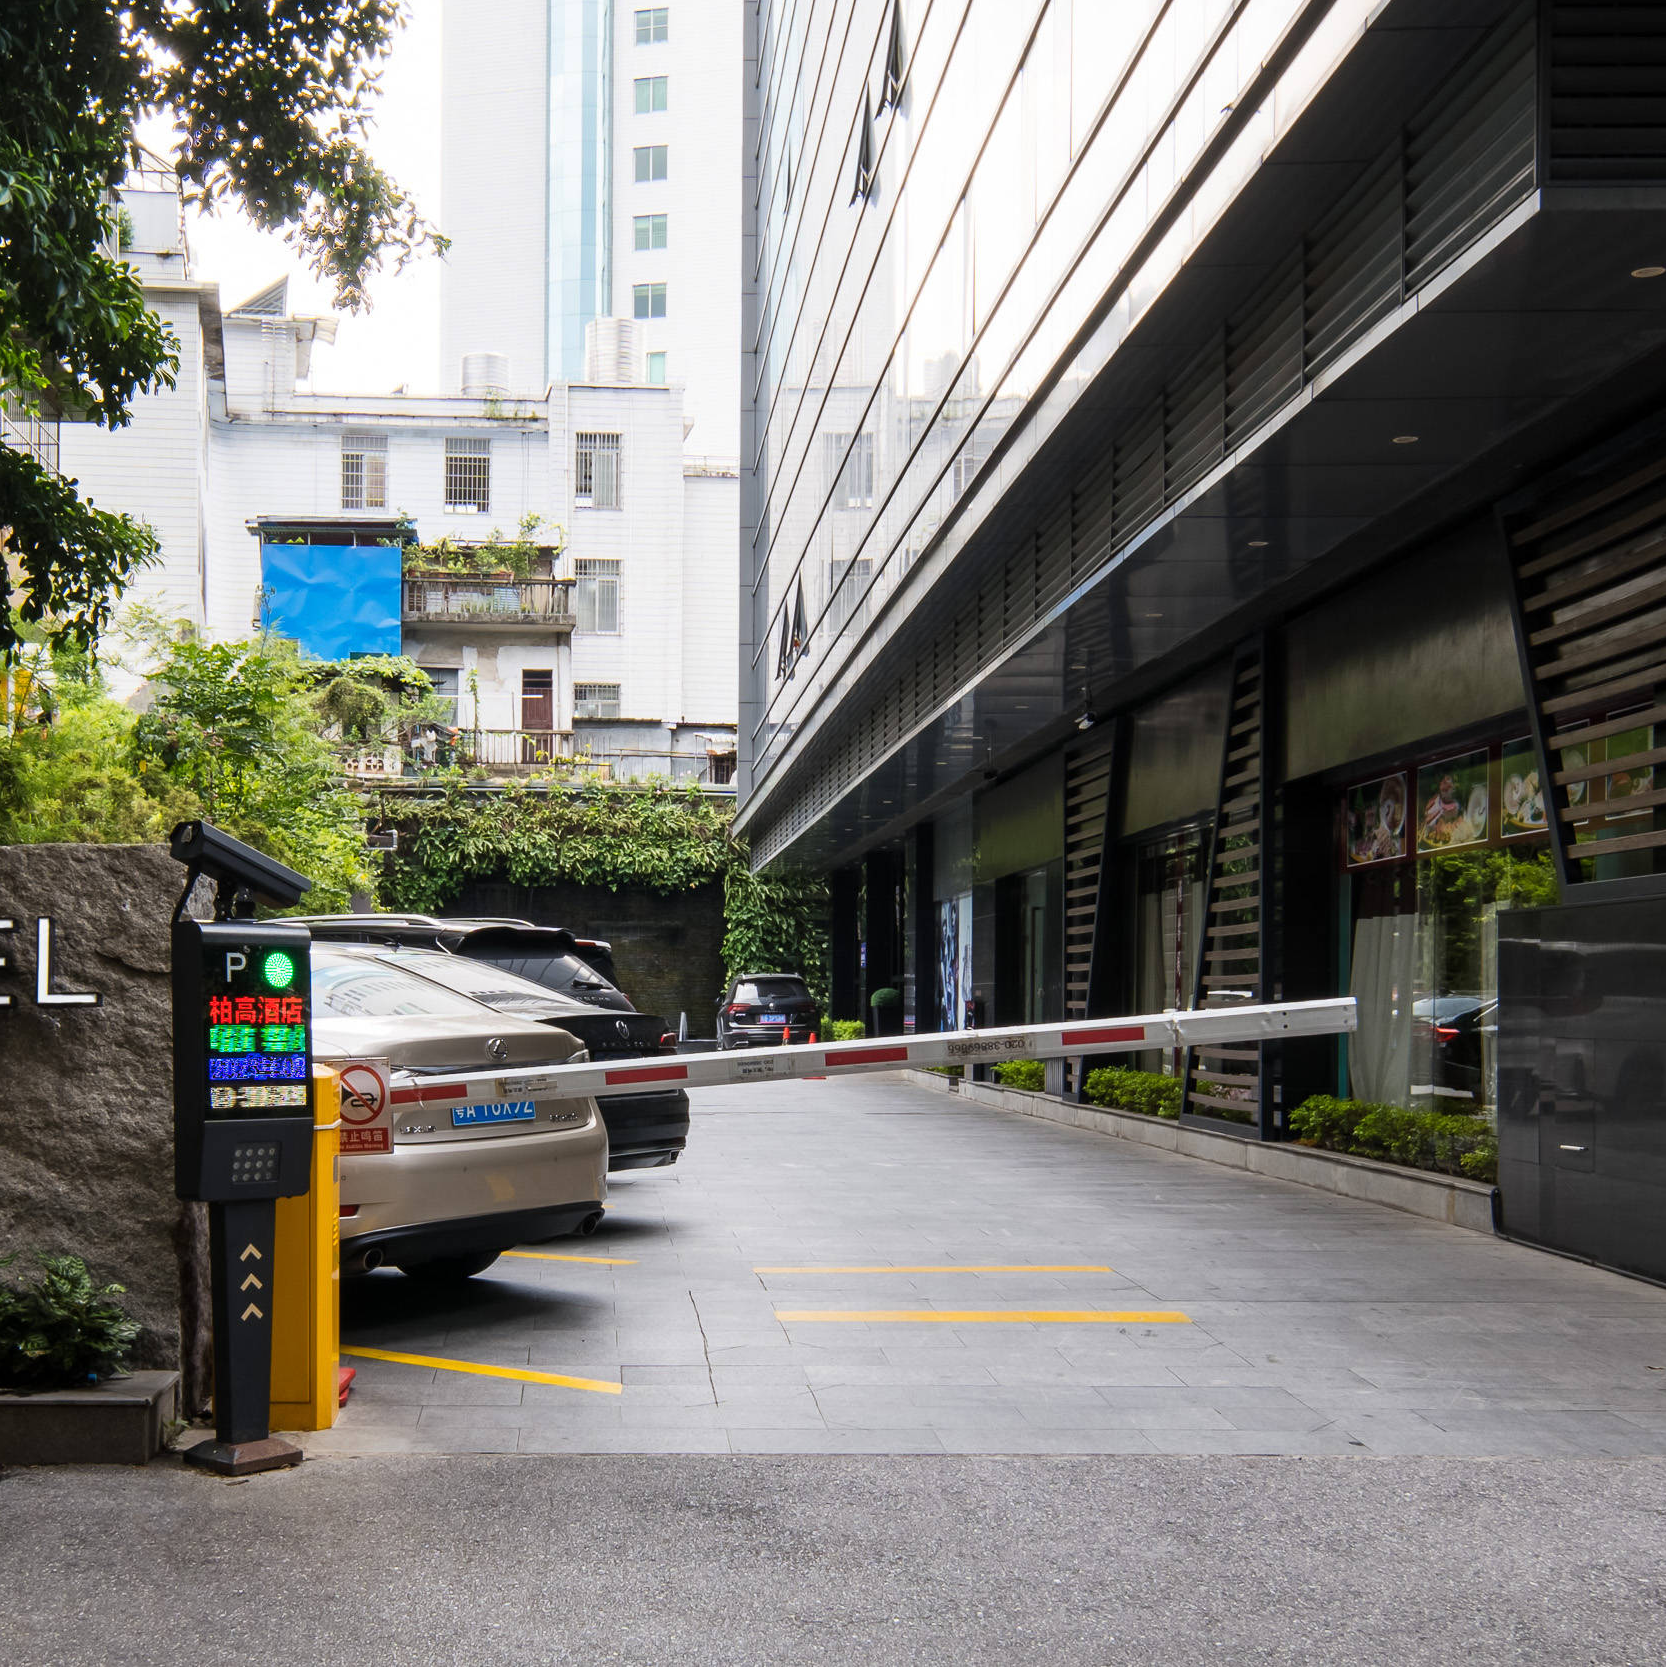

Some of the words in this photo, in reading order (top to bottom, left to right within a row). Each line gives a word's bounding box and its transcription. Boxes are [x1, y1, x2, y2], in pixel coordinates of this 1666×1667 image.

[226, 952, 247, 983] P
[209, 995, 303, 1025] 柏高酒店
